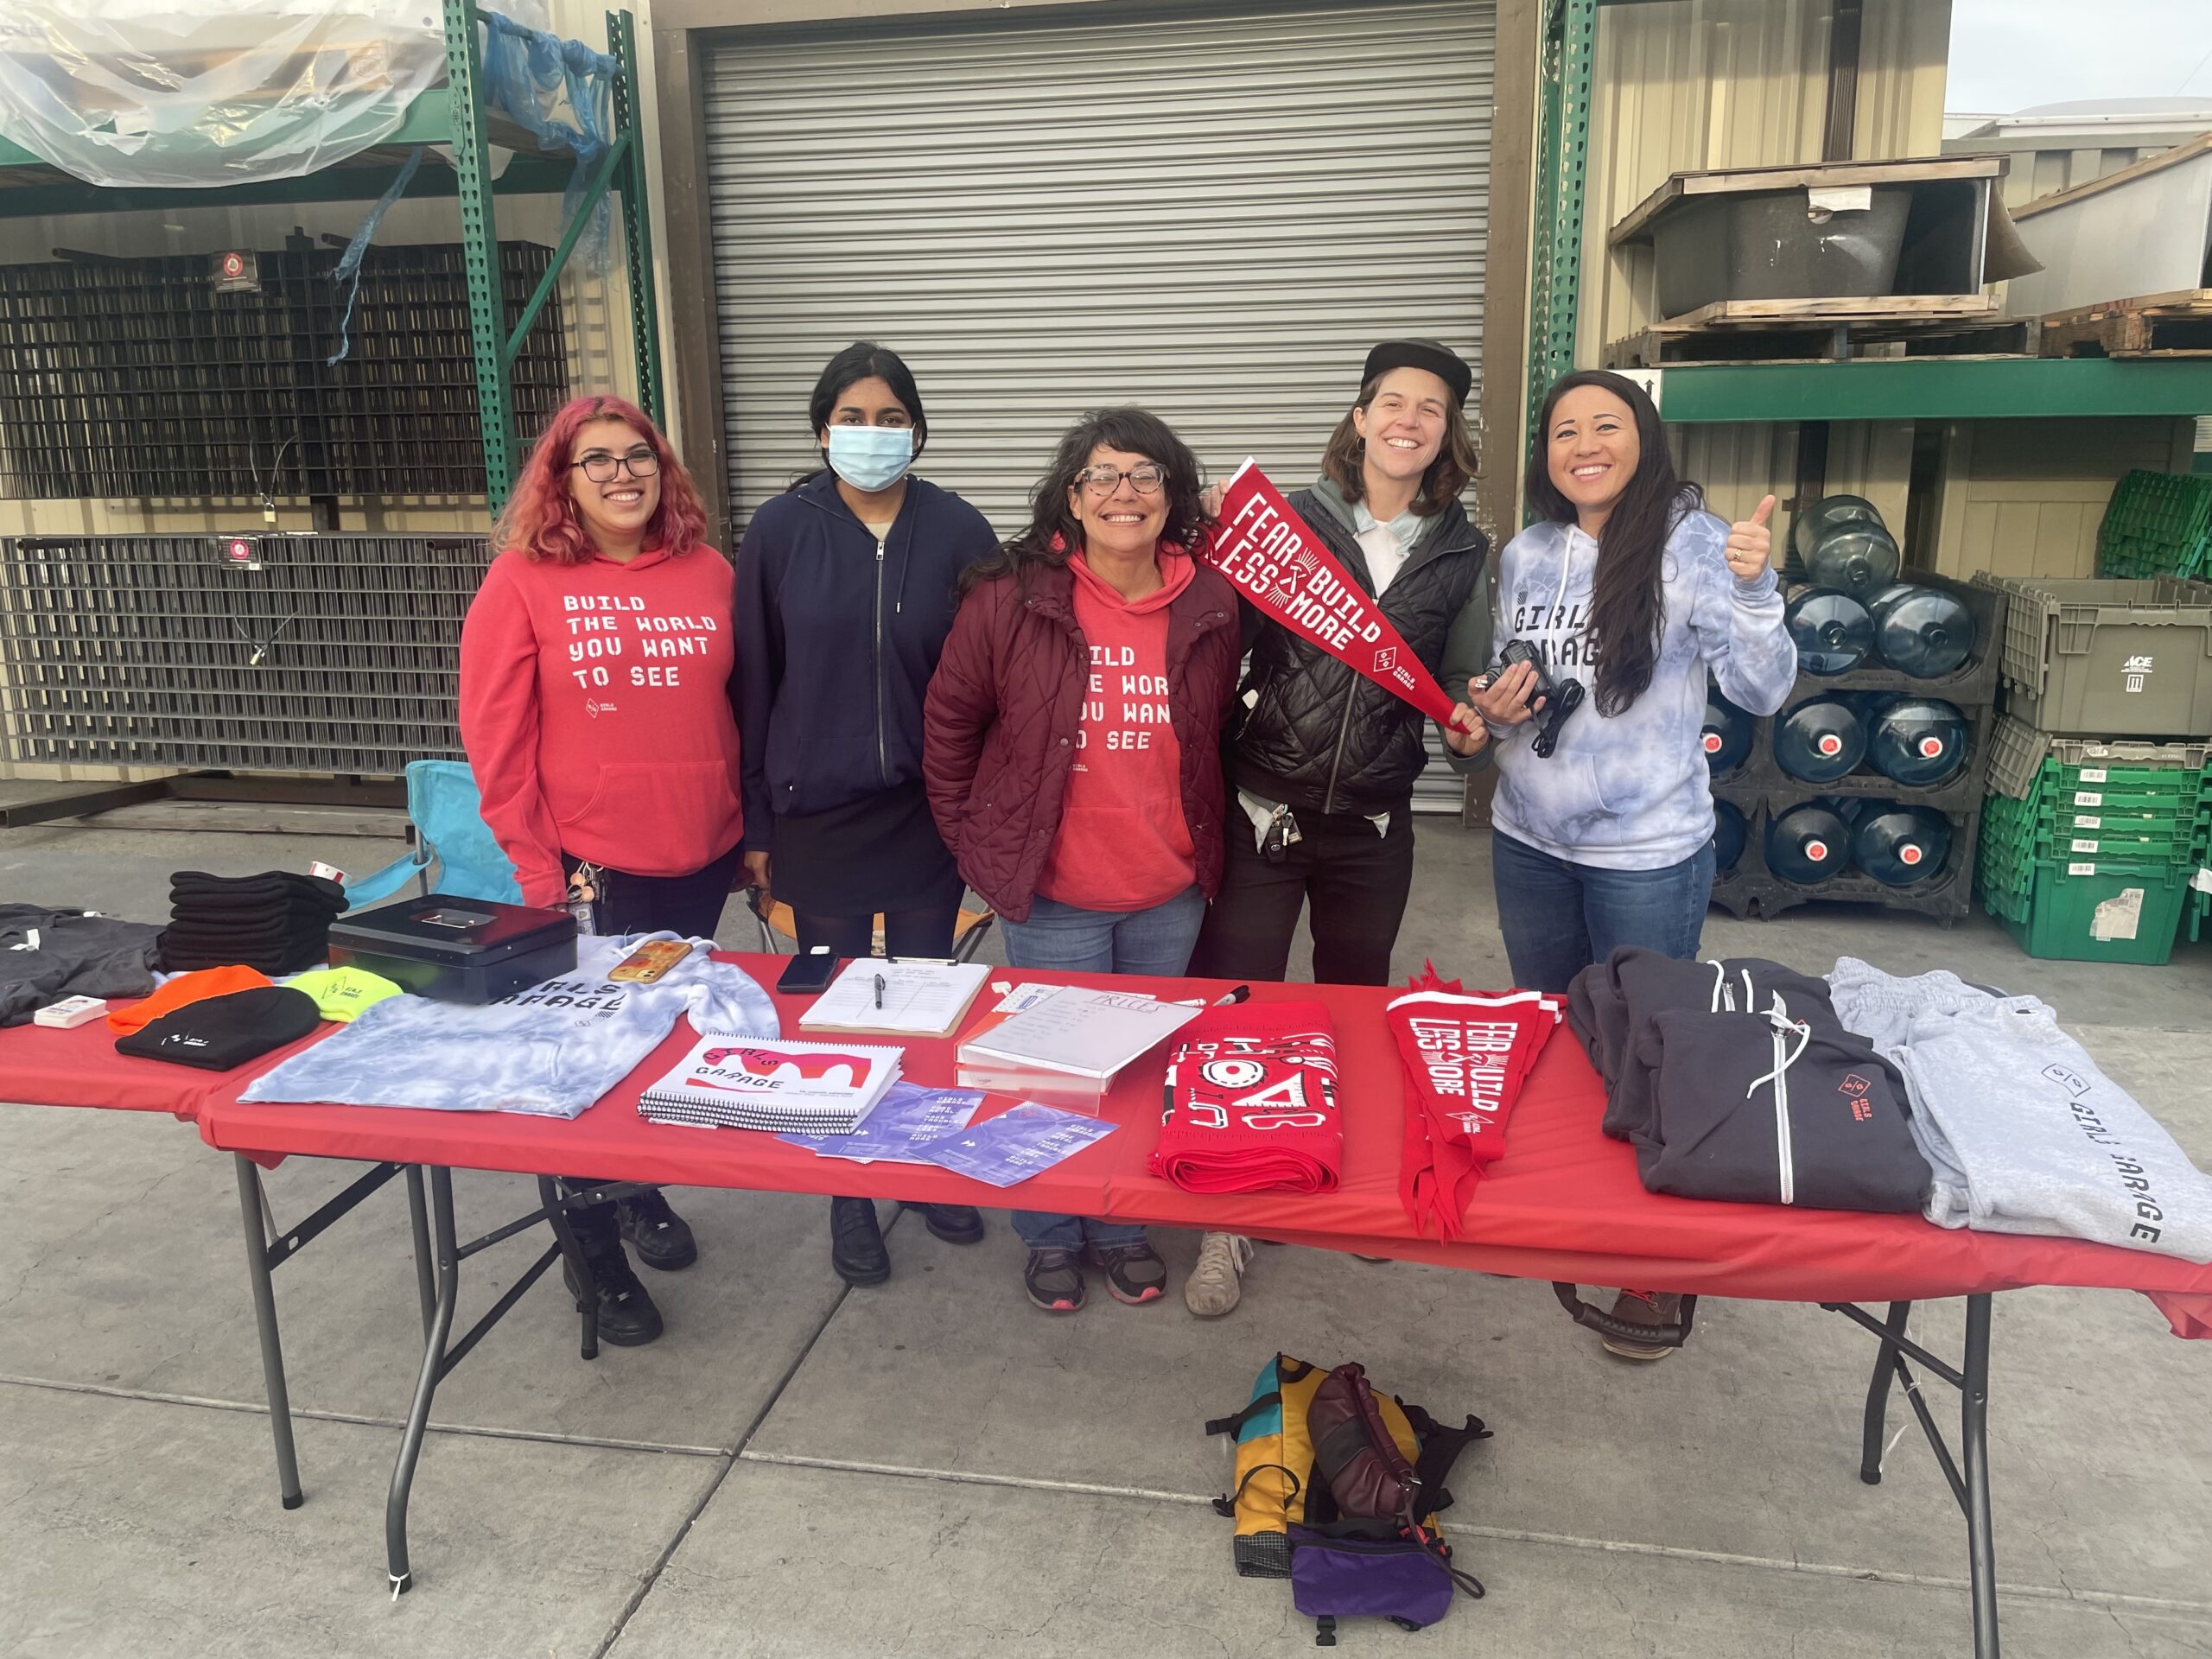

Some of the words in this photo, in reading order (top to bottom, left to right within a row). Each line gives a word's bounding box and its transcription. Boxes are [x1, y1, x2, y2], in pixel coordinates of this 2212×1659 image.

[1233, 492, 1302, 567] FEAR
[1205, 527, 1279, 594] LESS
[563, 595, 645, 612] BUILD
[1306, 565, 1382, 643] BUILD
[567, 616, 618, 635] THE
[636, 616, 717, 632] WORLD
[1284, 591, 1354, 651] MORE
[1515, 605, 1586, 633] GIRL
[569, 637, 622, 663] YOU
[643, 636, 709, 658] WANT
[1090, 645, 1135, 666] ILD
[2123, 655, 2153, 667] ACE
[573, 667, 609, 690] TO
[631, 666, 680, 688] SEE
[1122, 675, 1169, 696] WOR
[1393, 671, 1414, 691] GARAGE
[1123, 702, 1171, 723] WAN
[1106, 730, 1151, 750] SEE
[539, 981, 621, 995] RLS
[488, 993, 627, 1010] ARAGE
[1091, 994, 1167, 1013] PRICES
[703, 1048, 778, 1066] GIRLS
[695, 1066, 785, 1089] GARAGE
[1427, 1062, 1465, 1096] ORE
[1469, 1064, 1505, 1111] UILD
